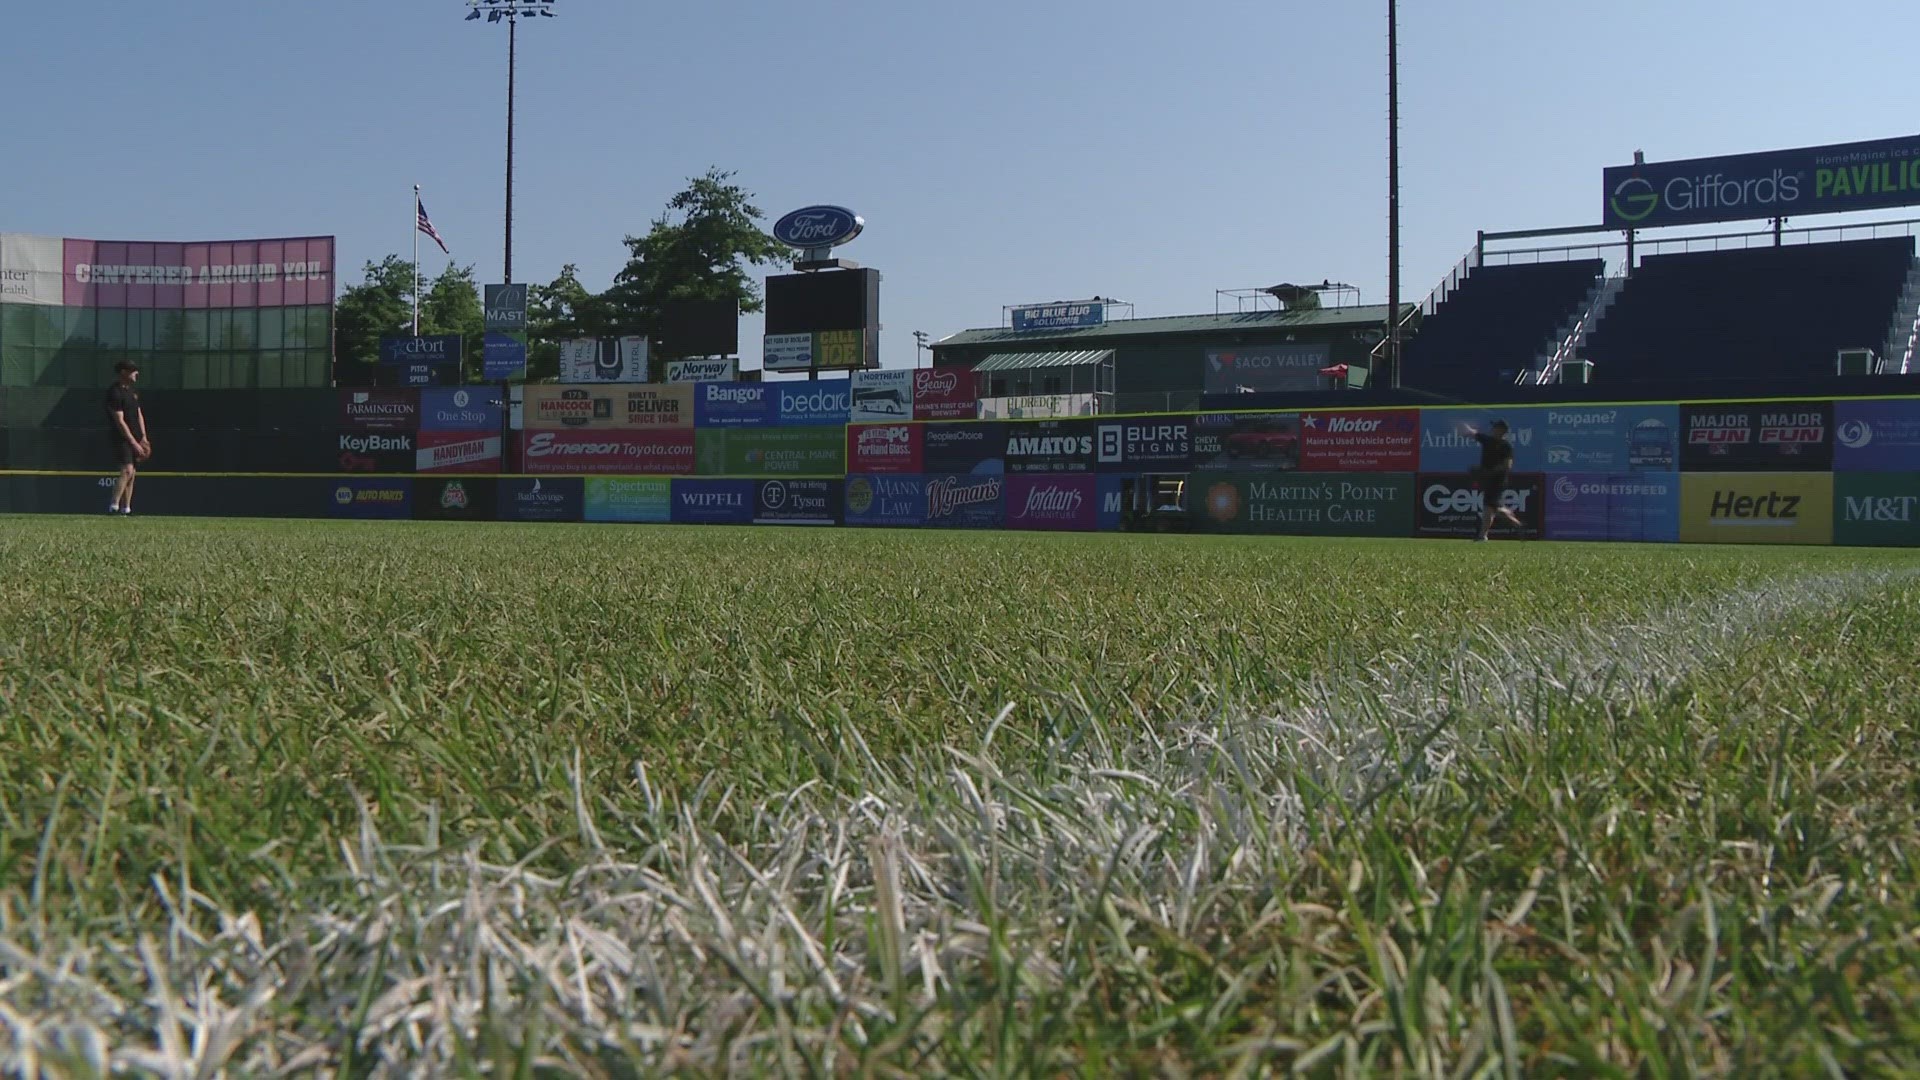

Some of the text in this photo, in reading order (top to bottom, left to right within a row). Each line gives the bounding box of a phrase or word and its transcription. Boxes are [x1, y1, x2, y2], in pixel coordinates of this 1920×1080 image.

[1664, 168, 1801, 212] Gifford's
[789, 213, 839, 240] Ford
[76, 260, 327, 285] CENTERED AROUND YOU.
[486, 310, 524, 321] MAST
[1024, 305, 1091, 319] BIG BLUE BUG
[1033, 316, 1079, 327] SOLUTIONS
[820, 330, 856, 345] CALL
[406, 338, 445, 353] cPort
[821, 344, 857, 366] JOE
[1235, 353, 1323, 369] SACO VALLEY
[410, 365, 428, 373] PITCH
[682, 362, 728, 376] Norway
[409, 375, 429, 383] SPEED
[863, 373, 905, 381] NORTHEAST
[916, 372, 957, 398] Geary
[706, 385, 764, 404] Bangor
[347, 403, 414, 414] FARMINGTON
[541, 401, 592, 410] HANCOCK
[628, 400, 679, 412] DELIVER
[437, 410, 486, 423] One Stop
[628, 414, 655, 424] SINCE
[1195, 414, 1231, 425] QUIRK
[1548, 411, 1616, 428] Propane?
[1690, 414, 1749, 428] MAJOR
[1760, 412, 1821, 427] MAJOR
[1327, 417, 1382, 433] Motor
[889, 427, 909, 443] PG
[1127, 426, 1187, 442] BURR
[1194, 436, 1217, 444] CHEVY
[1306, 436, 1413, 446] Maine's Used Vehicle Center
[1690, 428, 1746, 443] FUN
[1761, 427, 1819, 442] FUN
[339, 435, 411, 453] KeyBank
[433, 441, 485, 461] HANDYMAN
[527, 432, 693, 458] Emerson Toyota.com
[857, 443, 888, 456] Portland
[1006, 437, 1093, 455] AMATO'S
[1127, 443, 1188, 453] SIGNS
[1194, 445, 1222, 453] BLAZER
[765, 450, 806, 460] CENTRAL
[765, 461, 799, 471] POWER
[609, 480, 666, 493] Spectrum
[809, 481, 828, 491] Hiring
[874, 477, 920, 499] MANN
[1249, 482, 1398, 500] MARTIN'S POINT
[1580, 484, 1667, 495] GONETSPEED
[356, 489, 404, 501] AUTO PARTS
[517, 493, 564, 504] Bath Savings
[681, 493, 743, 507] WIPFLI
[791, 494, 826, 509] Tyson
[926, 476, 1000, 519] Wyman's
[1010, 485, 1082, 519] Jordan's
[1423, 484, 1530, 517] Geier
[880, 498, 913, 515] LAW
[1710, 490, 1801, 518] Hertz
[1844, 496, 1916, 522] M&T
[1249, 504, 1376, 523] HEALTH CARE
